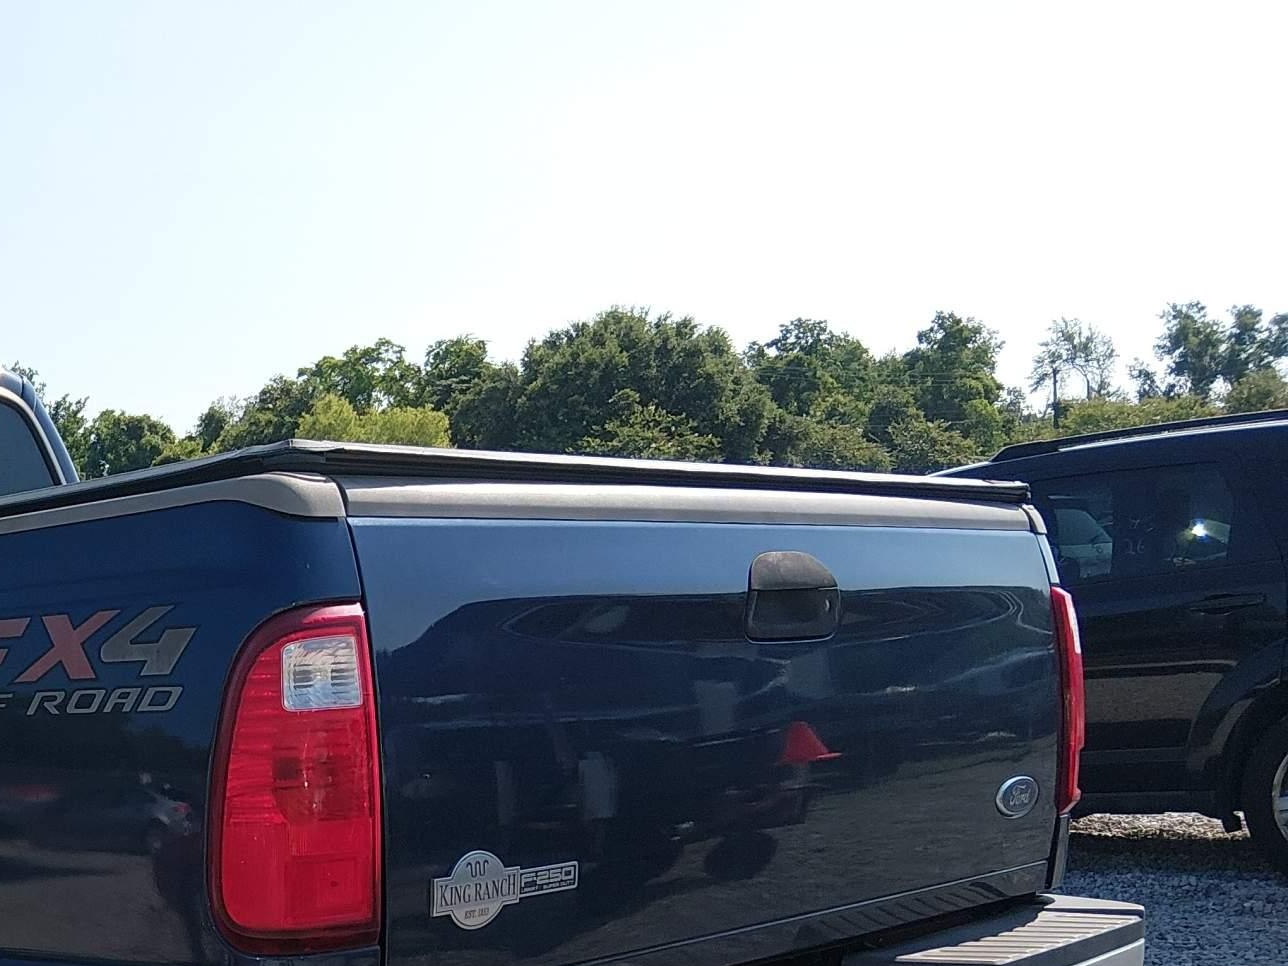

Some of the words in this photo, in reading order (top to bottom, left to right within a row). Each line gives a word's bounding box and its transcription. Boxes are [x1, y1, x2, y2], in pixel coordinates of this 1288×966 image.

[26, 686, 184, 716] ROAD
[1009, 784, 1032, 806] Ford
[439, 883, 472, 908] KING
[474, 873, 517, 901] RANCH
